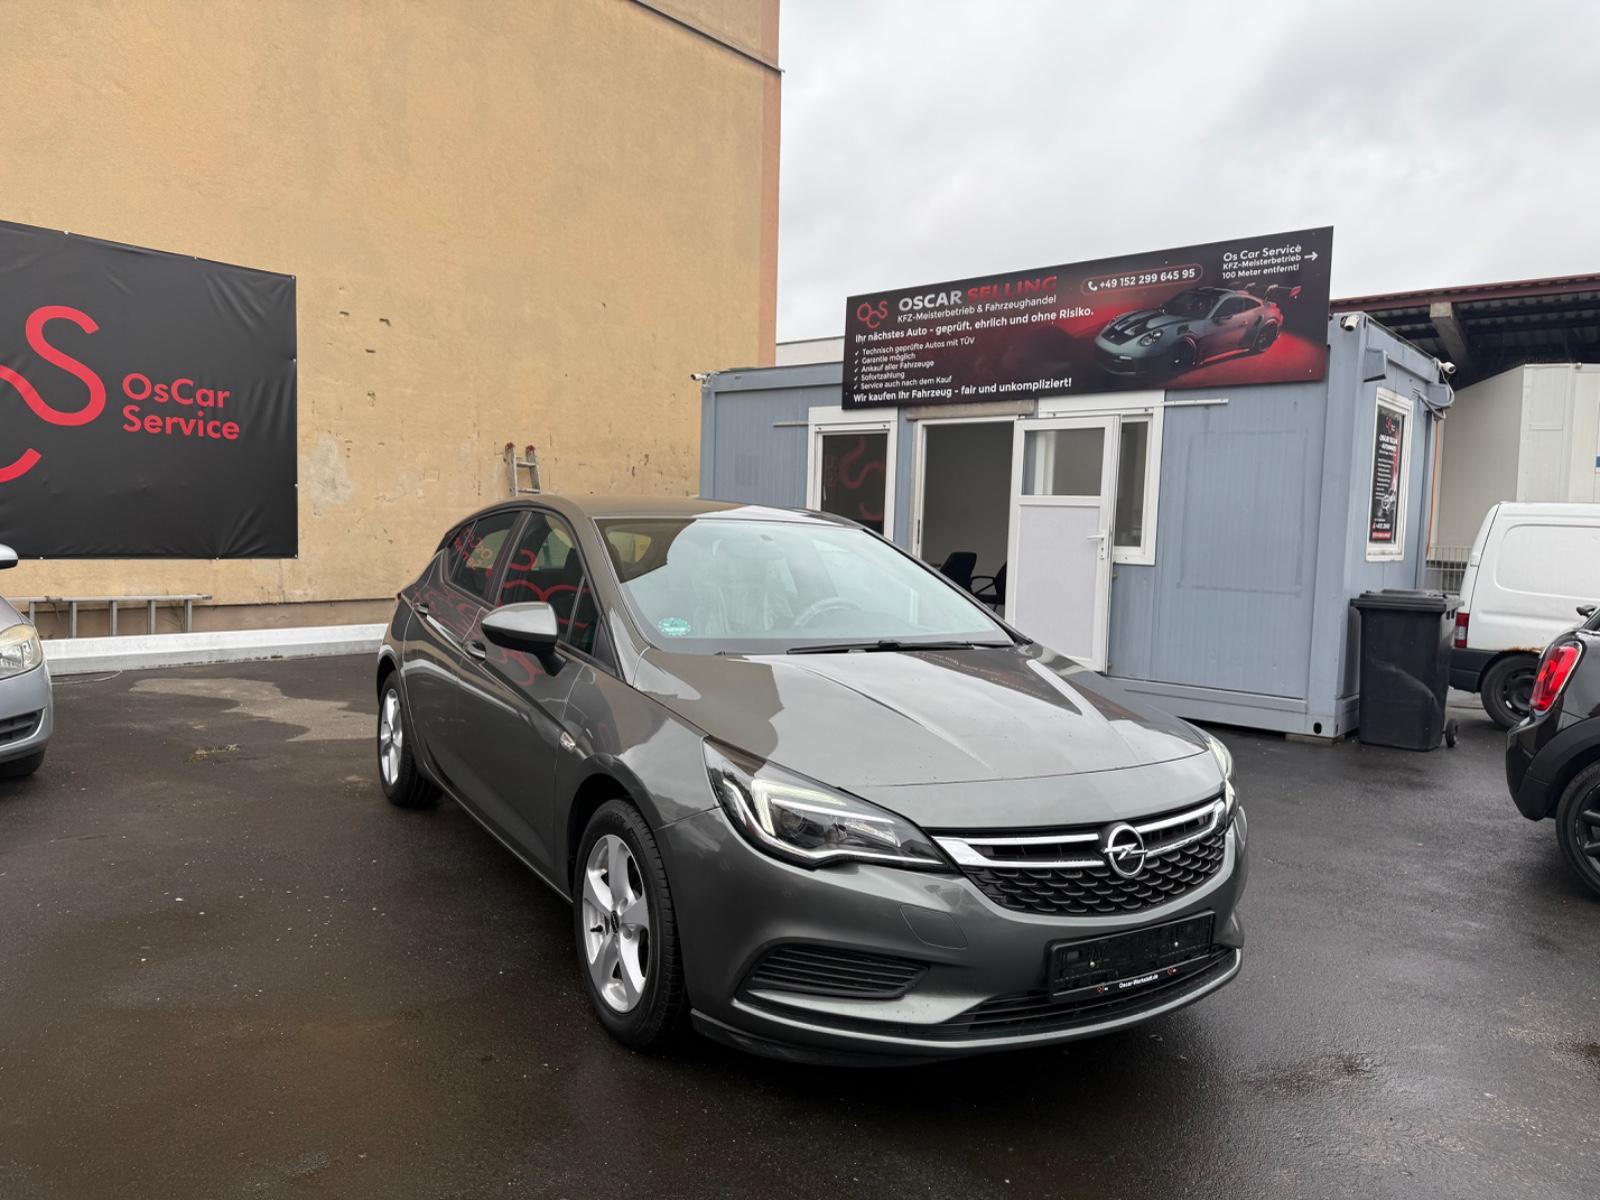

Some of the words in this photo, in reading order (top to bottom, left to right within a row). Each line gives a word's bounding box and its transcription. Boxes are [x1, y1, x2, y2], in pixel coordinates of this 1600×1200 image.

[1223, 252, 1238, 262] Os
[1240, 250, 1260, 260] Car
[1262, 244, 1302, 257] Service
[1223, 255, 1301, 270] KFZ-Meisterbetrieb
[1100, 278, 1117, 288] +49
[1120, 276, 1136, 287] 152
[1138, 273, 1158, 284] 299
[1160, 270, 1179, 281] 645
[1182, 269, 1195, 279] 95
[1222, 271, 1236, 279] 100
[1238, 269, 1261, 278] Meter
[1263, 263, 1299, 274] entfernt!
[898, 291, 962, 311] OSCAR
[967, 275, 1057, 302] SELLING
[897, 305, 975, 323] KFZ-Meisterbetrieb
[977, 305, 983, 313] &
[985, 294, 1057, 312] Fahrzeughandel
[855, 333, 867, 343] Ihr
[868, 329, 905, 342] nächstes
[906, 327, 927, 337] Auto
[974, 317, 1007, 329] ehrlich
[1009, 314, 1028, 325] und
[1031, 312, 1057, 323] ohne
[1059, 306, 1094, 319] Risiko.
[862, 344, 894, 355] Technisch
[895, 343, 923, 353] geprüfte
[924, 340, 945, 349] Autos
[946, 338, 958, 347] mit
[960, 336, 975, 345] TÜV
[861, 356, 888, 365] Garantie
[889, 353, 916, 363] möglich
[861, 363, 884, 373] Ankauf
[884, 362, 899, 371] aller
[899, 360, 935, 370] Fahrzeuge
[860, 382, 883, 390] Service
[884, 380, 900, 388] auch
[901, 378, 918, 386] nach
[919, 377, 935, 385] dem
[936, 375, 952, 383] Kauf
[861, 372, 905, 382] Sofortzahlung
[122, 373, 231, 408] OsCar
[853, 393, 867, 403] Wir
[868, 391, 896, 401] kaufen
[898, 390, 910, 400] Ihr
[911, 387, 952, 398] Fahrzeug
[961, 384, 976, 395] fair
[978, 383, 996, 393] und
[999, 377, 1072, 392] unkompliziert!
[122, 404, 240, 440] Service
